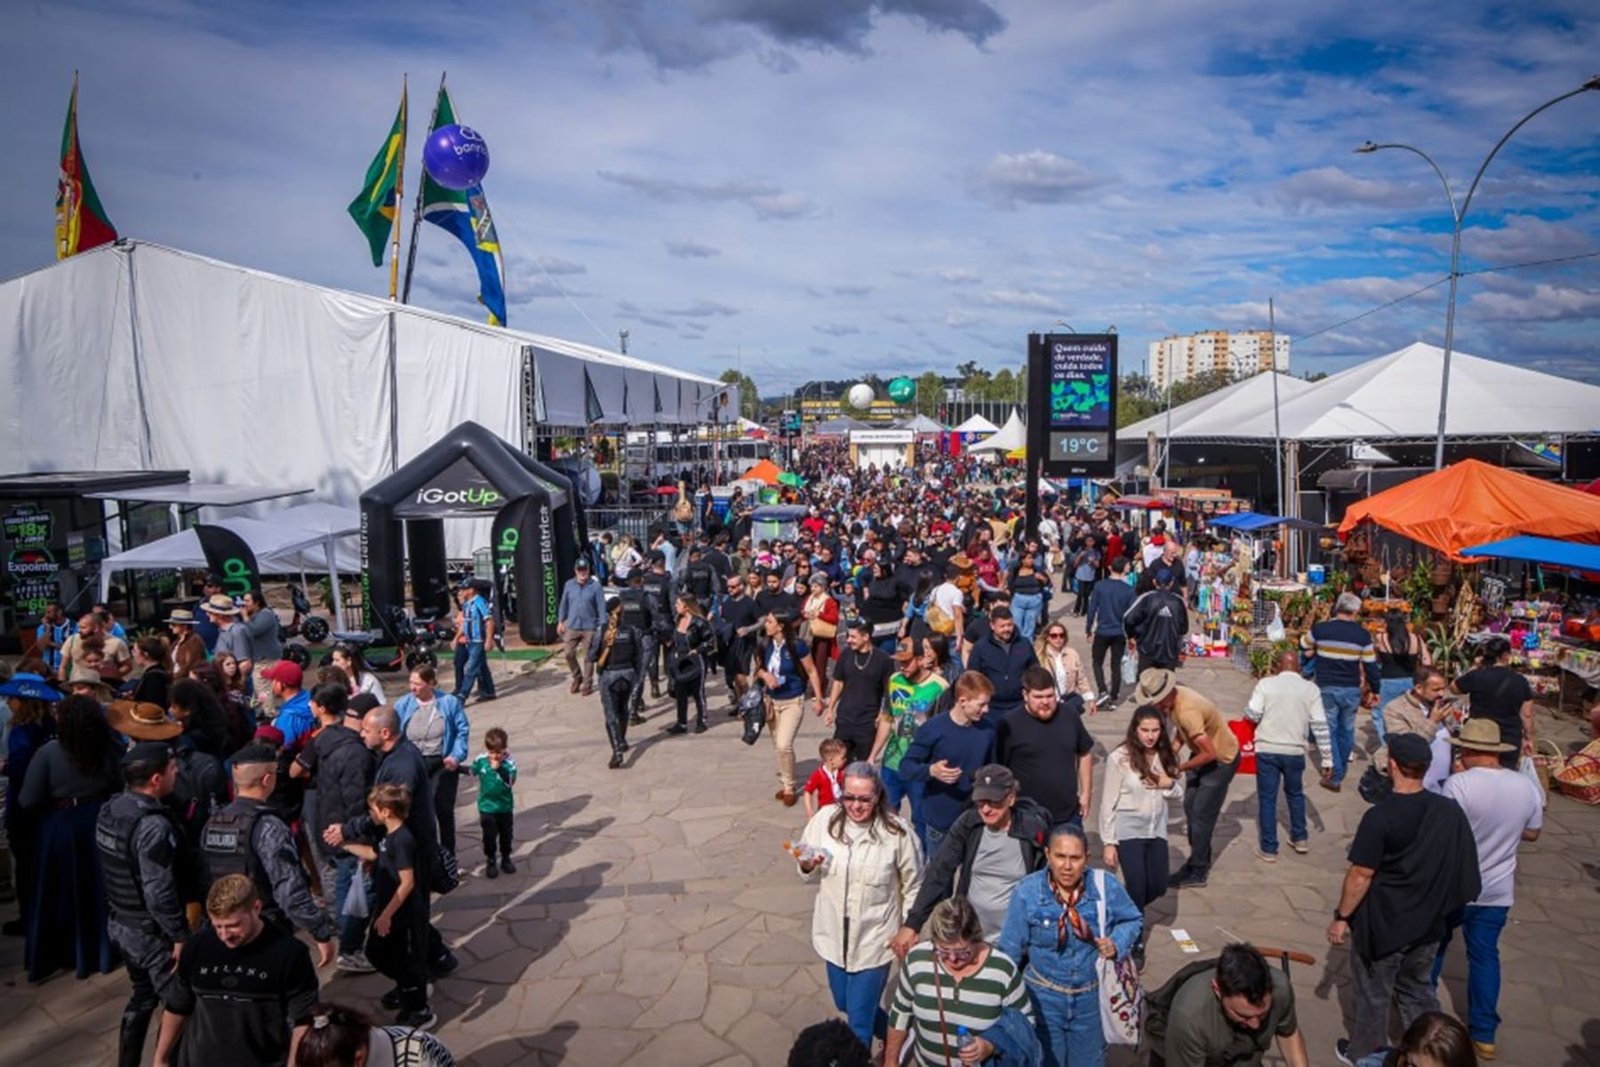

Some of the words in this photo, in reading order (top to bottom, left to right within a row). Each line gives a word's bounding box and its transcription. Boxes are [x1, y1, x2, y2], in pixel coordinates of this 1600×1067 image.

[1054, 344, 1081, 353] Quem
[1060, 438, 1099, 453] 19°C
[416, 487, 499, 506] iGotUp
[8, 561, 59, 573] Expointer
[544, 562, 557, 625] Scooter
[200, 964, 268, 980] MILANO
